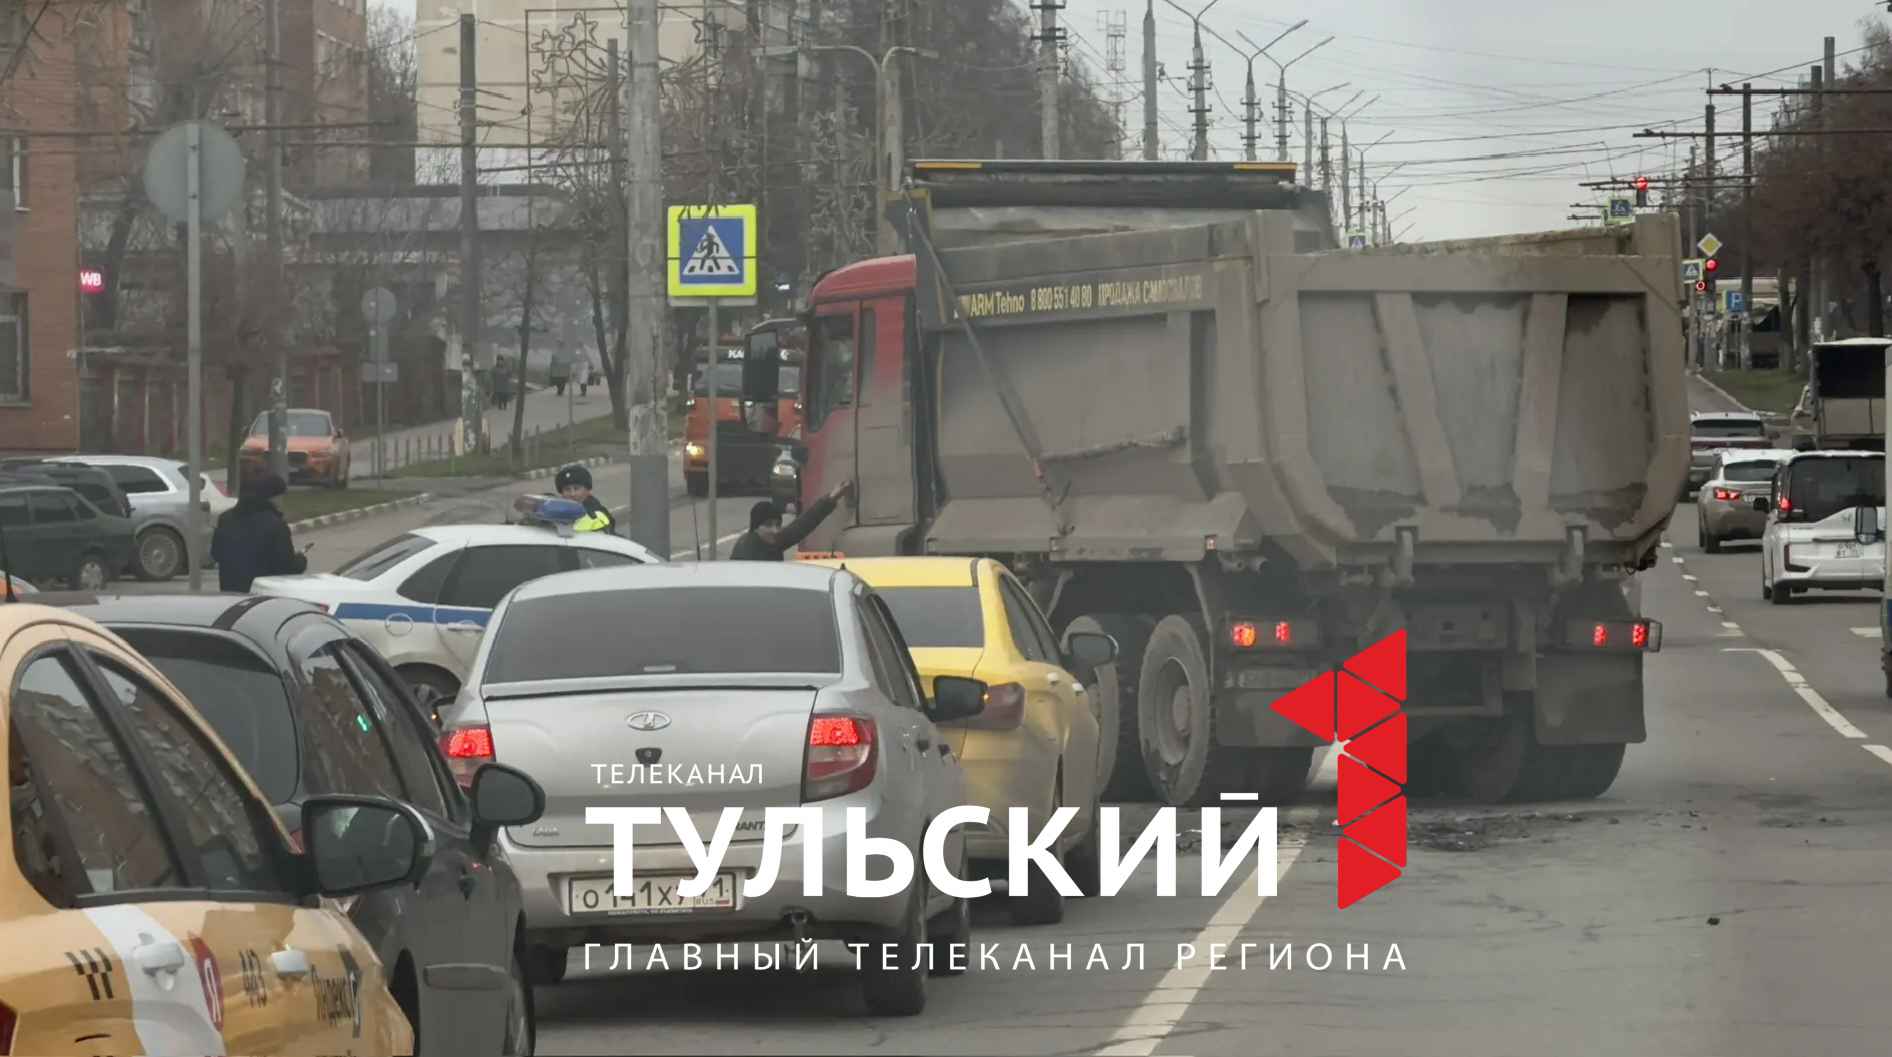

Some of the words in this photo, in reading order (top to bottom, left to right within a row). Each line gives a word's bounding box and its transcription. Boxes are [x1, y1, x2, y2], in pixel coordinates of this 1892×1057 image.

[80, 271, 102, 287] WB
[996, 291, 1025, 314] Tehno
[1030, 288, 1037, 311] 8
[1731, 292, 1744, 309] P
